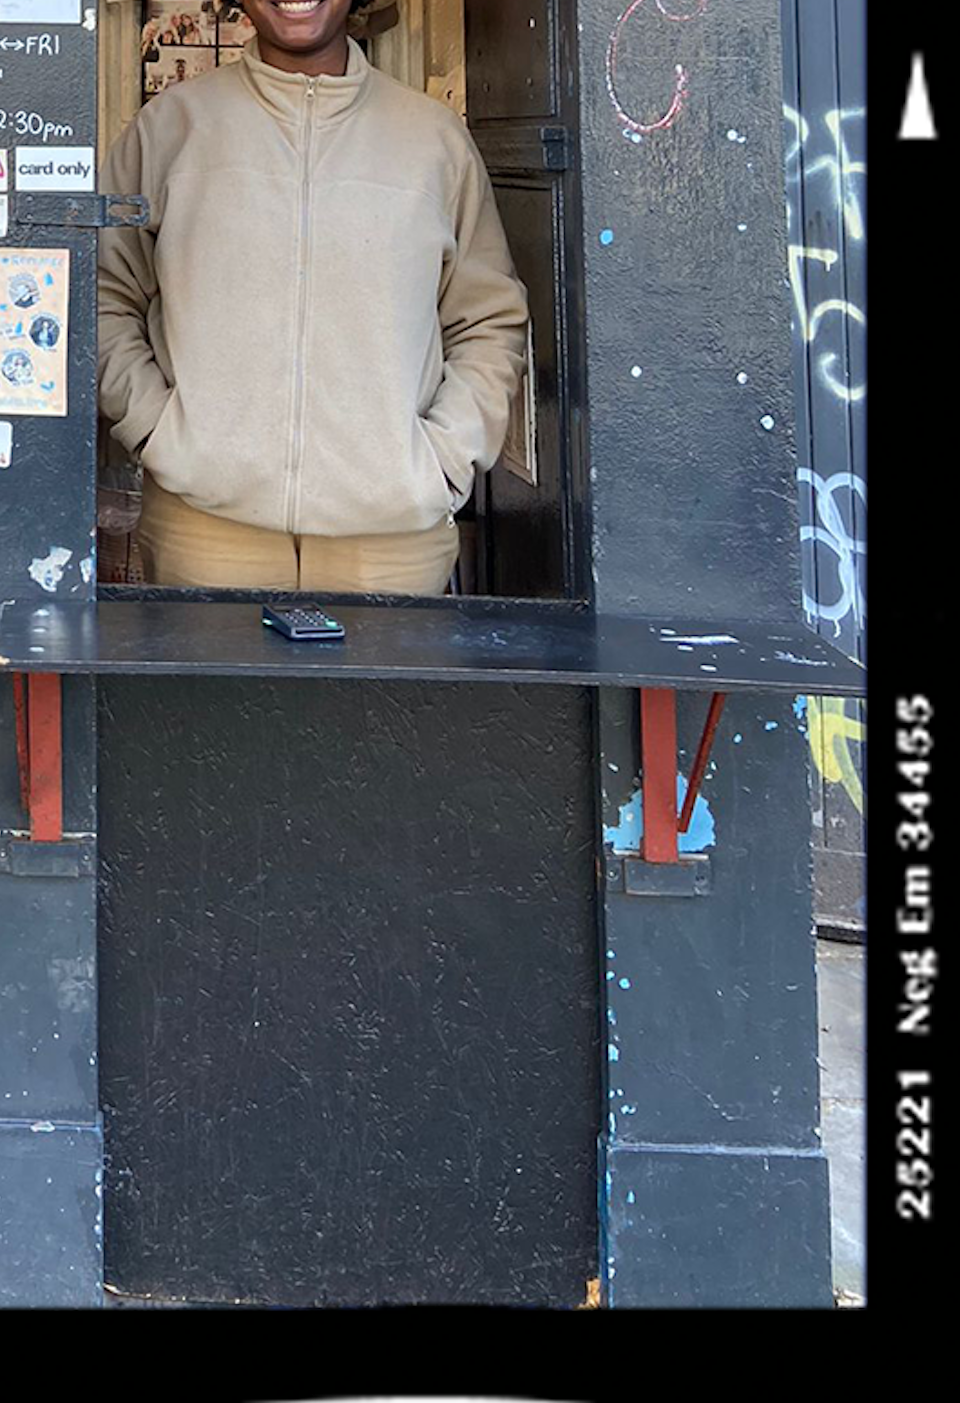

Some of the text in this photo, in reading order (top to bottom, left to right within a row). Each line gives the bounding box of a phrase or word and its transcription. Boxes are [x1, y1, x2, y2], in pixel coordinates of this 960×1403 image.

[26, 33, 59, 55] FRI
[19, 161, 91, 178] card only
